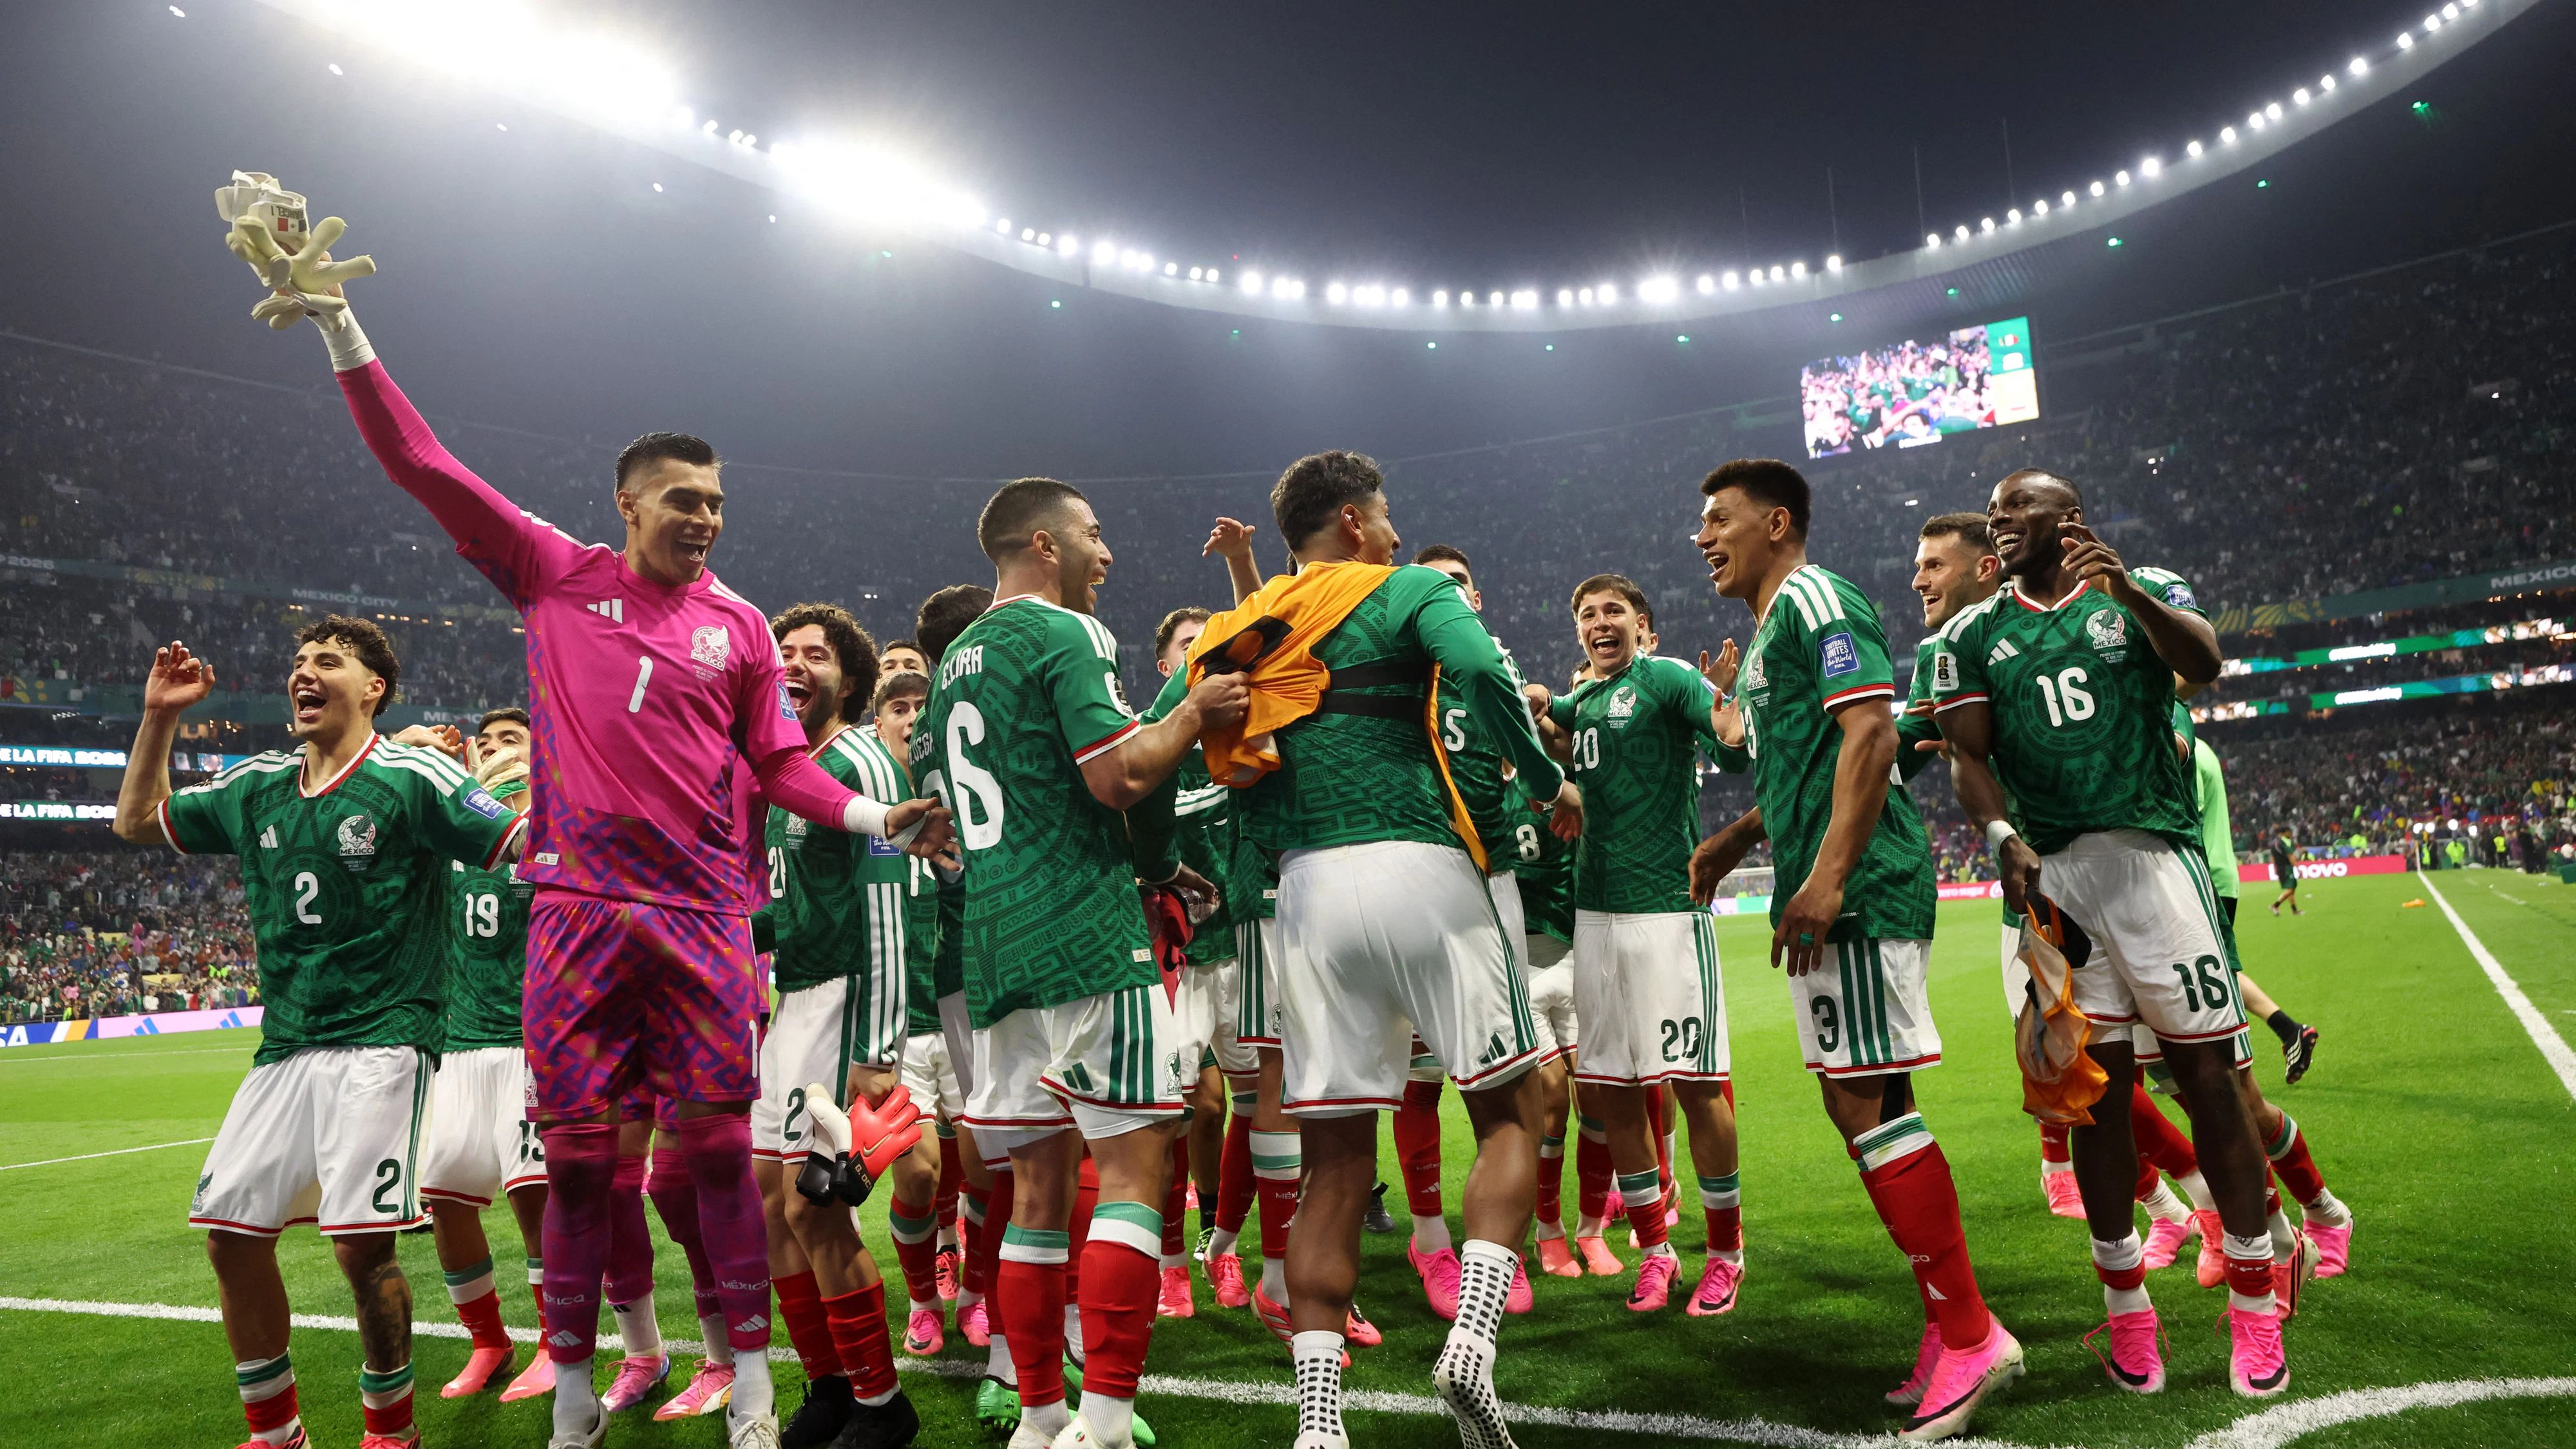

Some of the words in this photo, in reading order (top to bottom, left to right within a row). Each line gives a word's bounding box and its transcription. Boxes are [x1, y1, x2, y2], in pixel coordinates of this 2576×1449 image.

[8, 556, 54, 569] 2026
[292, 589, 358, 604] MEXICO
[361, 596, 398, 607] CITY
[1824, 638, 1847, 651] FOOTBALL
[1826, 645, 1849, 659] UNITES
[1835, 653, 1852, 664] World
[2094, 638, 2125, 648] MÉXICO
[629, 656, 653, 713] 1
[2036, 667, 2095, 727] 16
[424, 711, 484, 724] MEXIC
[1444, 709, 1466, 752] 5
[1740, 705, 1757, 759] 3
[0, 748, 12, 761] E
[13, 748, 36, 762] LA
[37, 750, 73, 764] FIFA
[1572, 728, 1600, 772] 20
[947, 701, 1004, 850] 6
[0, 804, 12, 817] E
[14, 804, 37, 817] LA
[37, 805, 74, 818] FIFA
[75, 805, 117, 819] 202
[1516, 824, 1540, 863] 8
[2268, 862, 2348, 881] Lnovo
[296, 872, 322, 924] 2
[466, 893, 498, 937] 19
[2173, 955, 2229, 1013] 16
[1661, 1016, 1702, 1063] 20
[373, 1159, 400, 1213] 2
